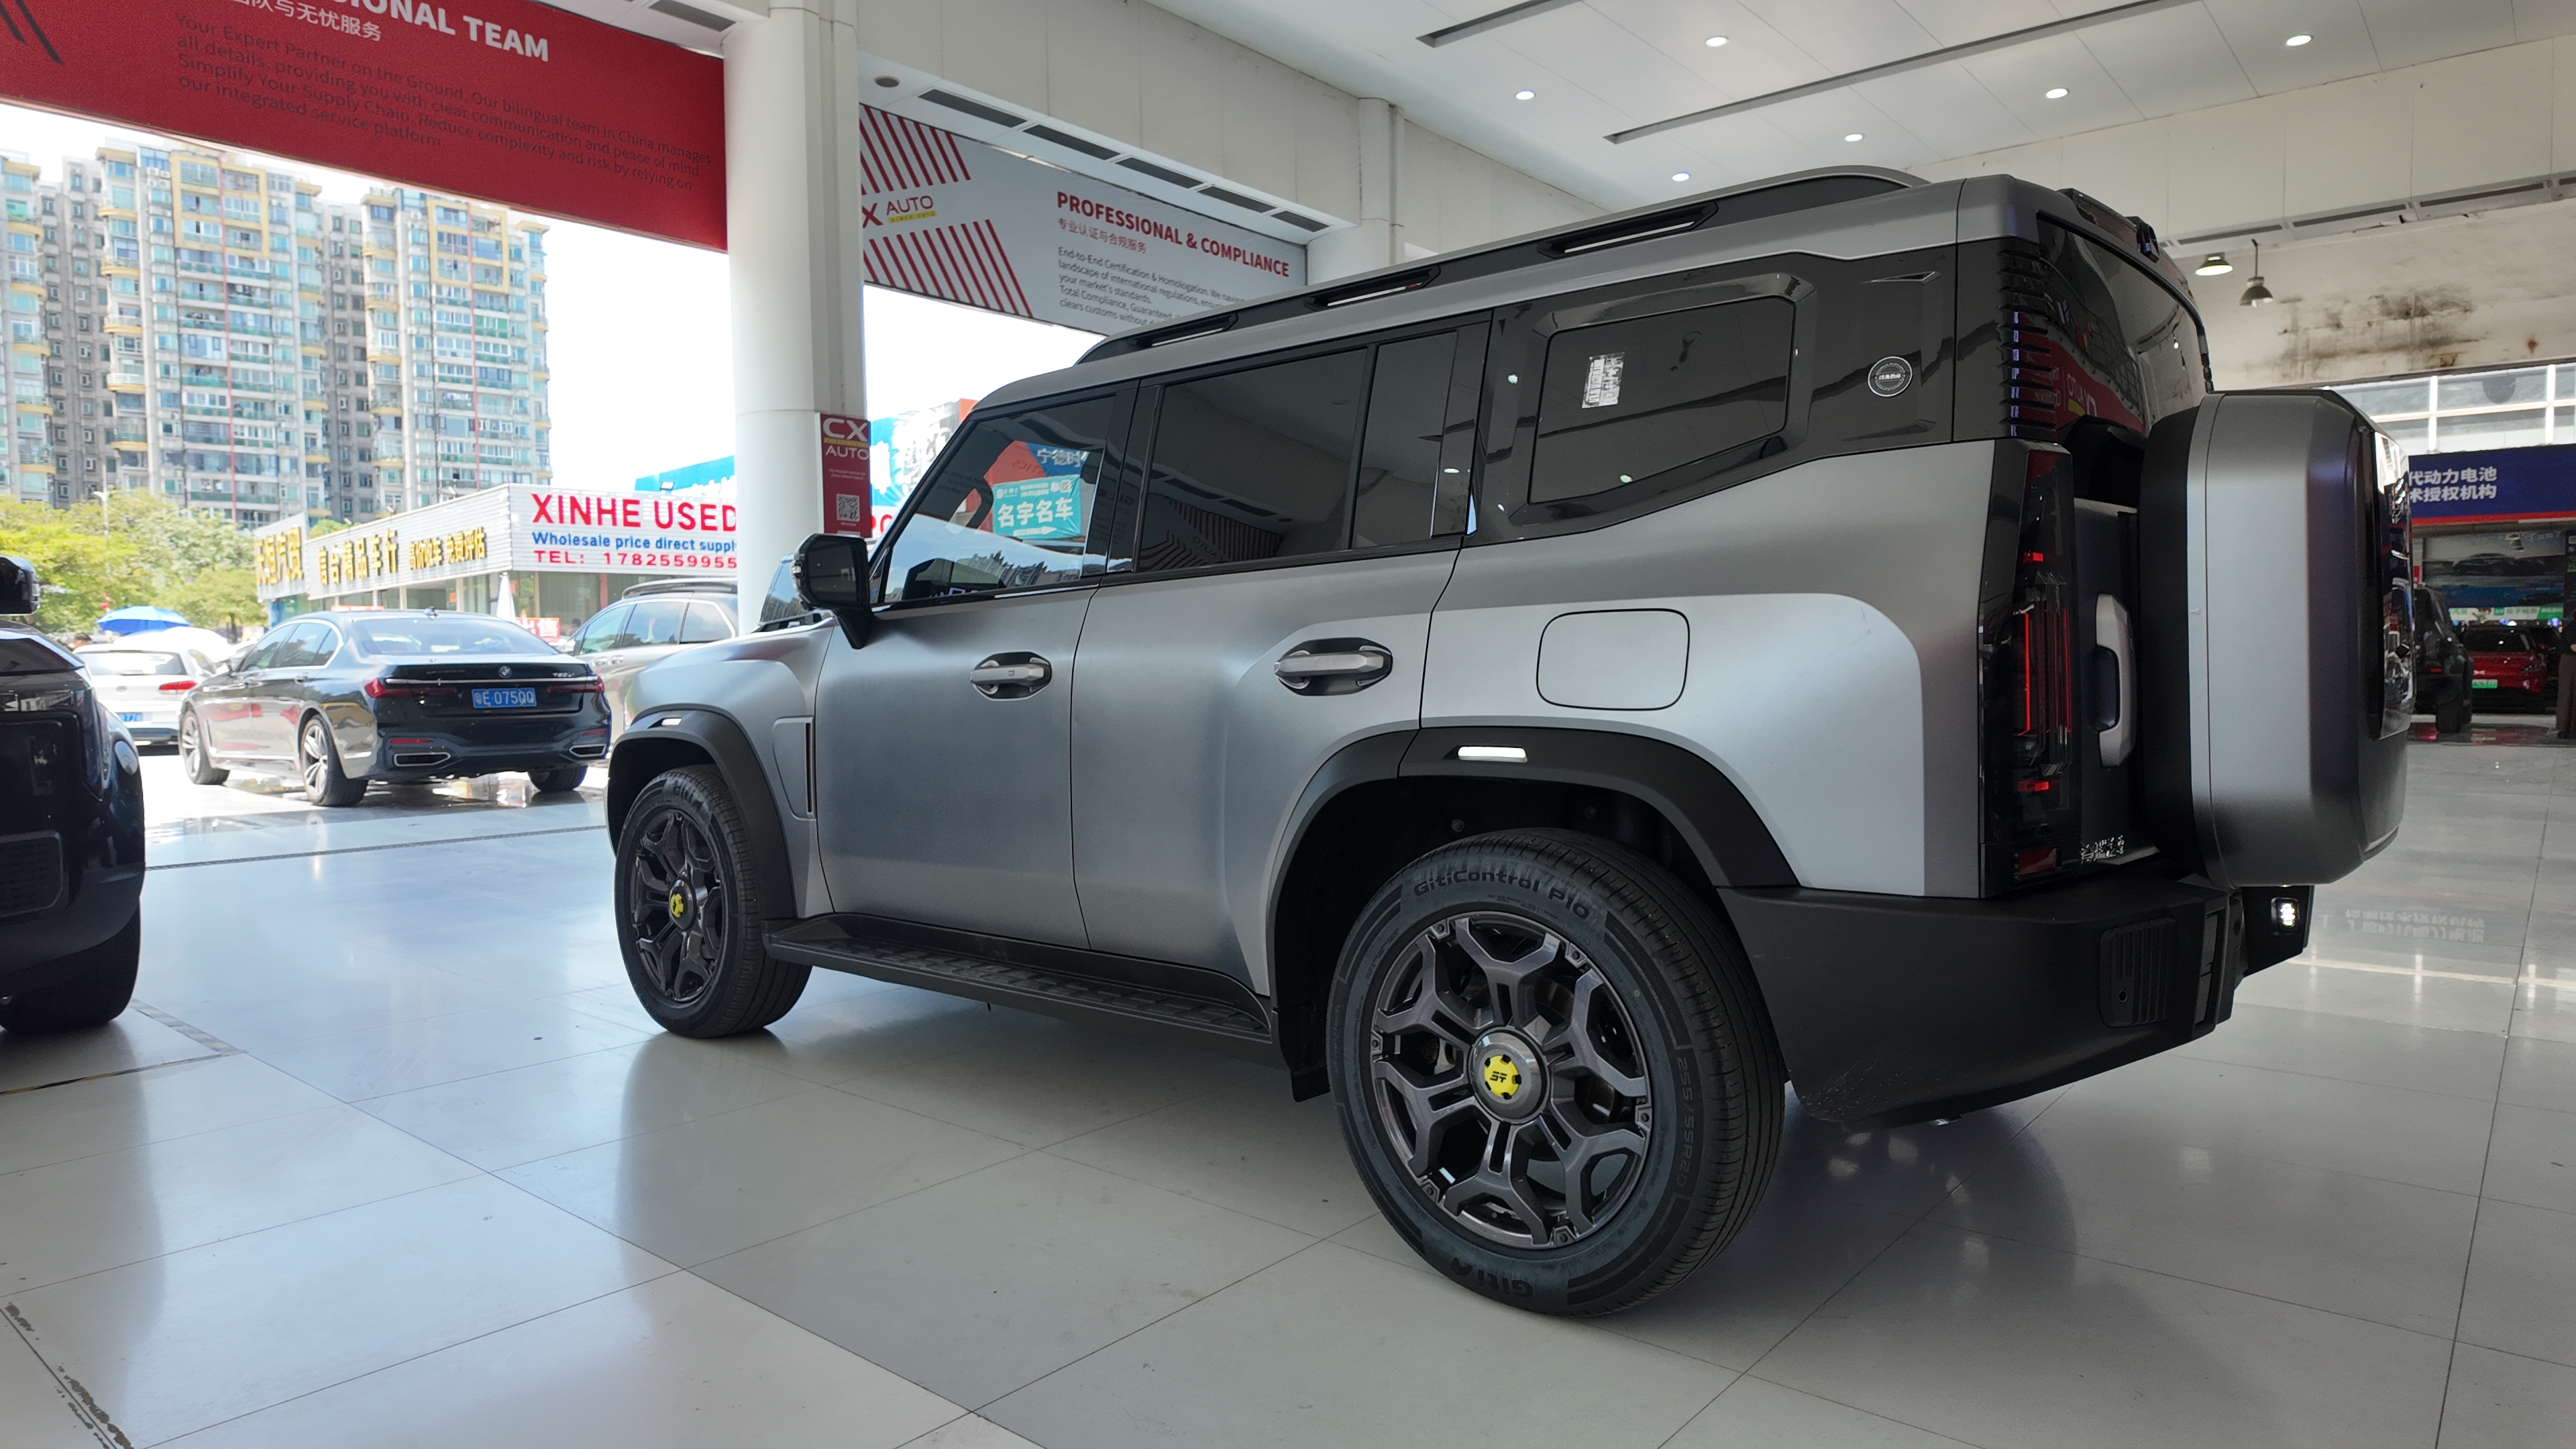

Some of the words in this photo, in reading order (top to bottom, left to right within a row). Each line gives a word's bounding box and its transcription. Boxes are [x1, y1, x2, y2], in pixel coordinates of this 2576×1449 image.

[333, 0, 455, 35] ONAL
[463, 15, 549, 62] TEAM
[176, 13, 217, 34] Your
[223, 26, 279, 52] Expert
[285, 42, 347, 68] Partner
[352, 62, 372, 75] on
[377, 68, 403, 84] the
[472, 93, 499, 109] Our
[504, 100, 563, 125] bilingual
[567, 118, 600, 135] team
[604, 126, 615, 139] in
[619, 131, 654, 149] China
[658, 142, 712, 164] manages
[177, 36, 199, 51] all
[276, 62, 357, 95] providing
[361, 85, 390, 100] you
[394, 91, 427, 108] with
[431, 101, 468, 118] clear
[472, 111, 582, 147] communication
[585, 140, 610, 154] and
[614, 146, 651, 164] peace
[653, 156, 667, 168] of
[669, 160, 700, 176] mind
[179, 76, 211, 93] our
[216, 84, 308, 117] integrated
[311, 108, 370, 131] service
[178, 53, 254, 87] Simplify
[260, 75, 298, 93] Your
[303, 85, 360, 112] Supply
[419, 114, 475, 136] Reduce
[478, 130, 555, 160] complexity
[559, 149, 584, 164] and
[588, 156, 610, 170] risk
[614, 162, 629, 177] by
[633, 168, 674, 190] relying
[677, 180, 692, 191] on
[886, 195, 934, 215] AUTO
[1057, 191, 1183, 246] PROFESSIONAL
[1186, 233, 1198, 250] &
[1201, 237, 1289, 278] COMPLIANCE
[1058, 218, 1147, 254] 专业认证与合规服务
[1058, 247, 1104, 266] End-to-End
[1104, 260, 1150, 279] Certification
[1059, 259, 1100, 278] landscape
[1110, 273, 1159, 294] international
[1059, 274, 1078, 284] your
[1059, 284, 1080, 299] Total
[1059, 298, 1085, 312] clears
[1085, 305, 1118, 320] customs
[822, 417, 868, 442] CX
[824, 445, 870, 461] AUTO
[2409, 466, 2498, 487] 代动力电池
[2410, 483, 2498, 503] 术授权机构
[531, 493, 641, 528] XINHE
[654, 500, 737, 532] USED
[409, 537, 443, 570] 高价收车
[445, 527, 487, 564] 免费评估
[532, 532, 610, 547] Wholesale
[615, 535, 651, 550] price
[655, 537, 695, 551] direct
[700, 539, 737, 553] suppl
[533, 550, 585, 565] TEL:
[603, 552, 737, 570] 1782559955
[1413, 869, 1540, 897] GitiControl
[1548, 887, 1591, 920] P10
[1677, 1057, 1695, 1188] 255/55R20
